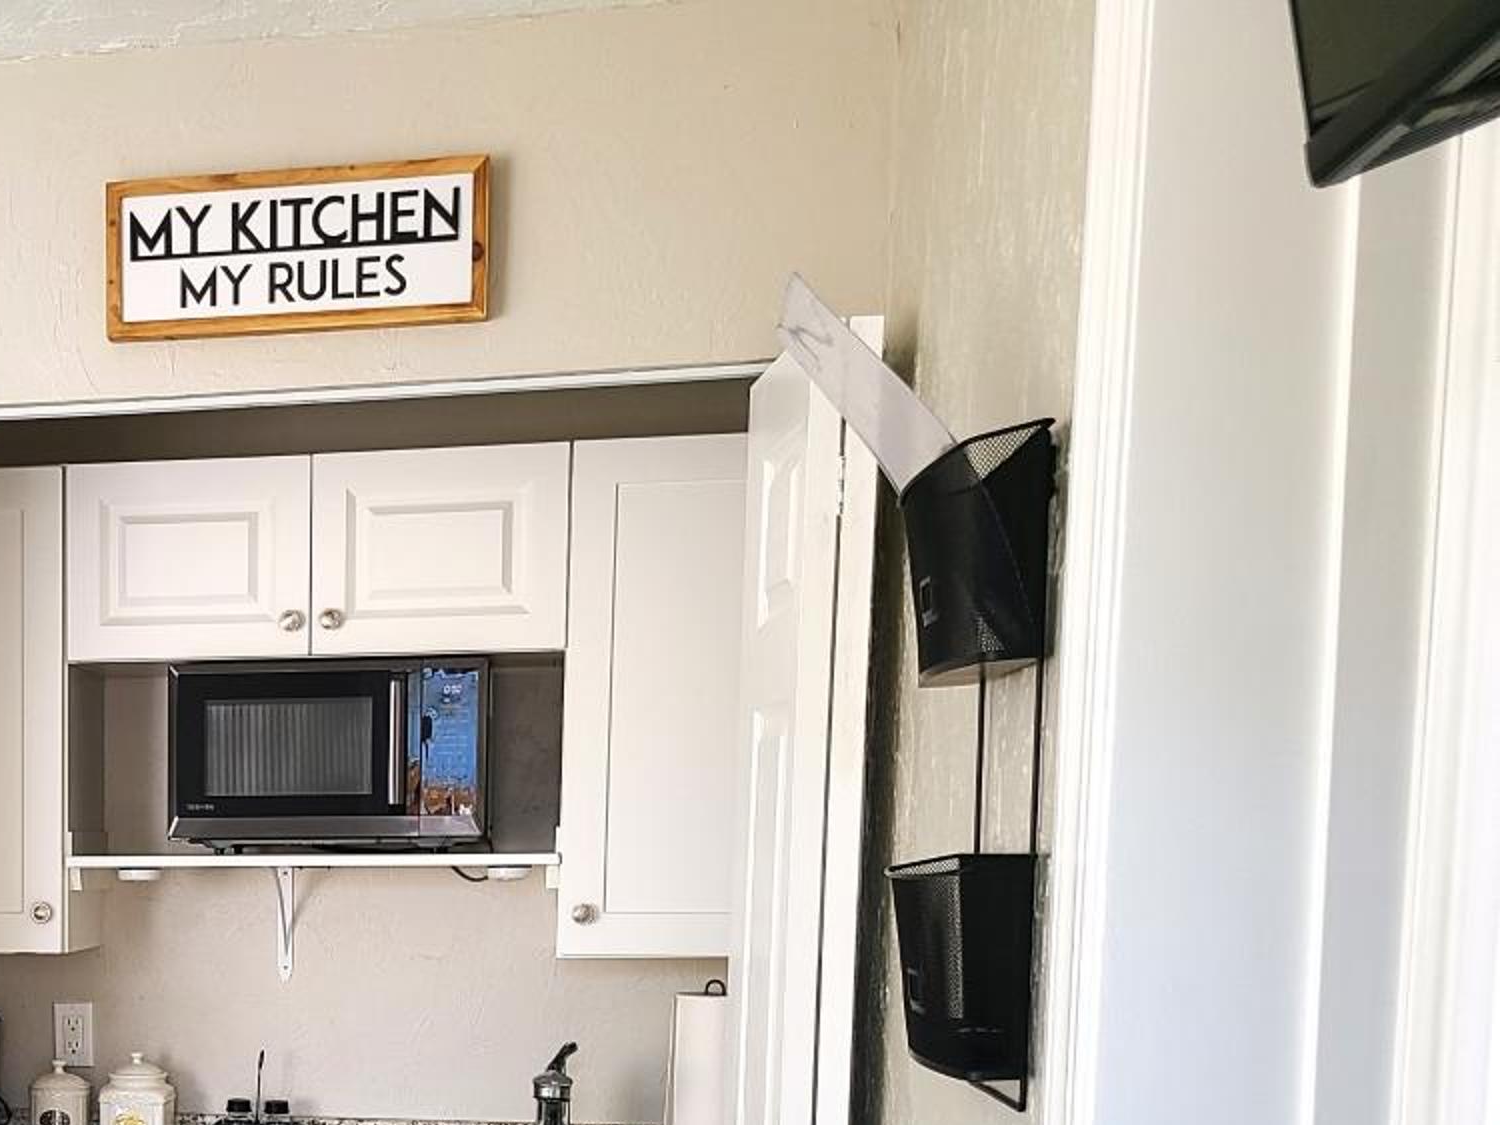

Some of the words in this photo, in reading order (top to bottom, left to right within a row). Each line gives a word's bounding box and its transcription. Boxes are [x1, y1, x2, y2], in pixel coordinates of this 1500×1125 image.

[130, 205, 212, 262] MY
[231, 187, 460, 254] KITCHEN
[181, 264, 252, 308] MY
[269, 254, 407, 302] RULES
